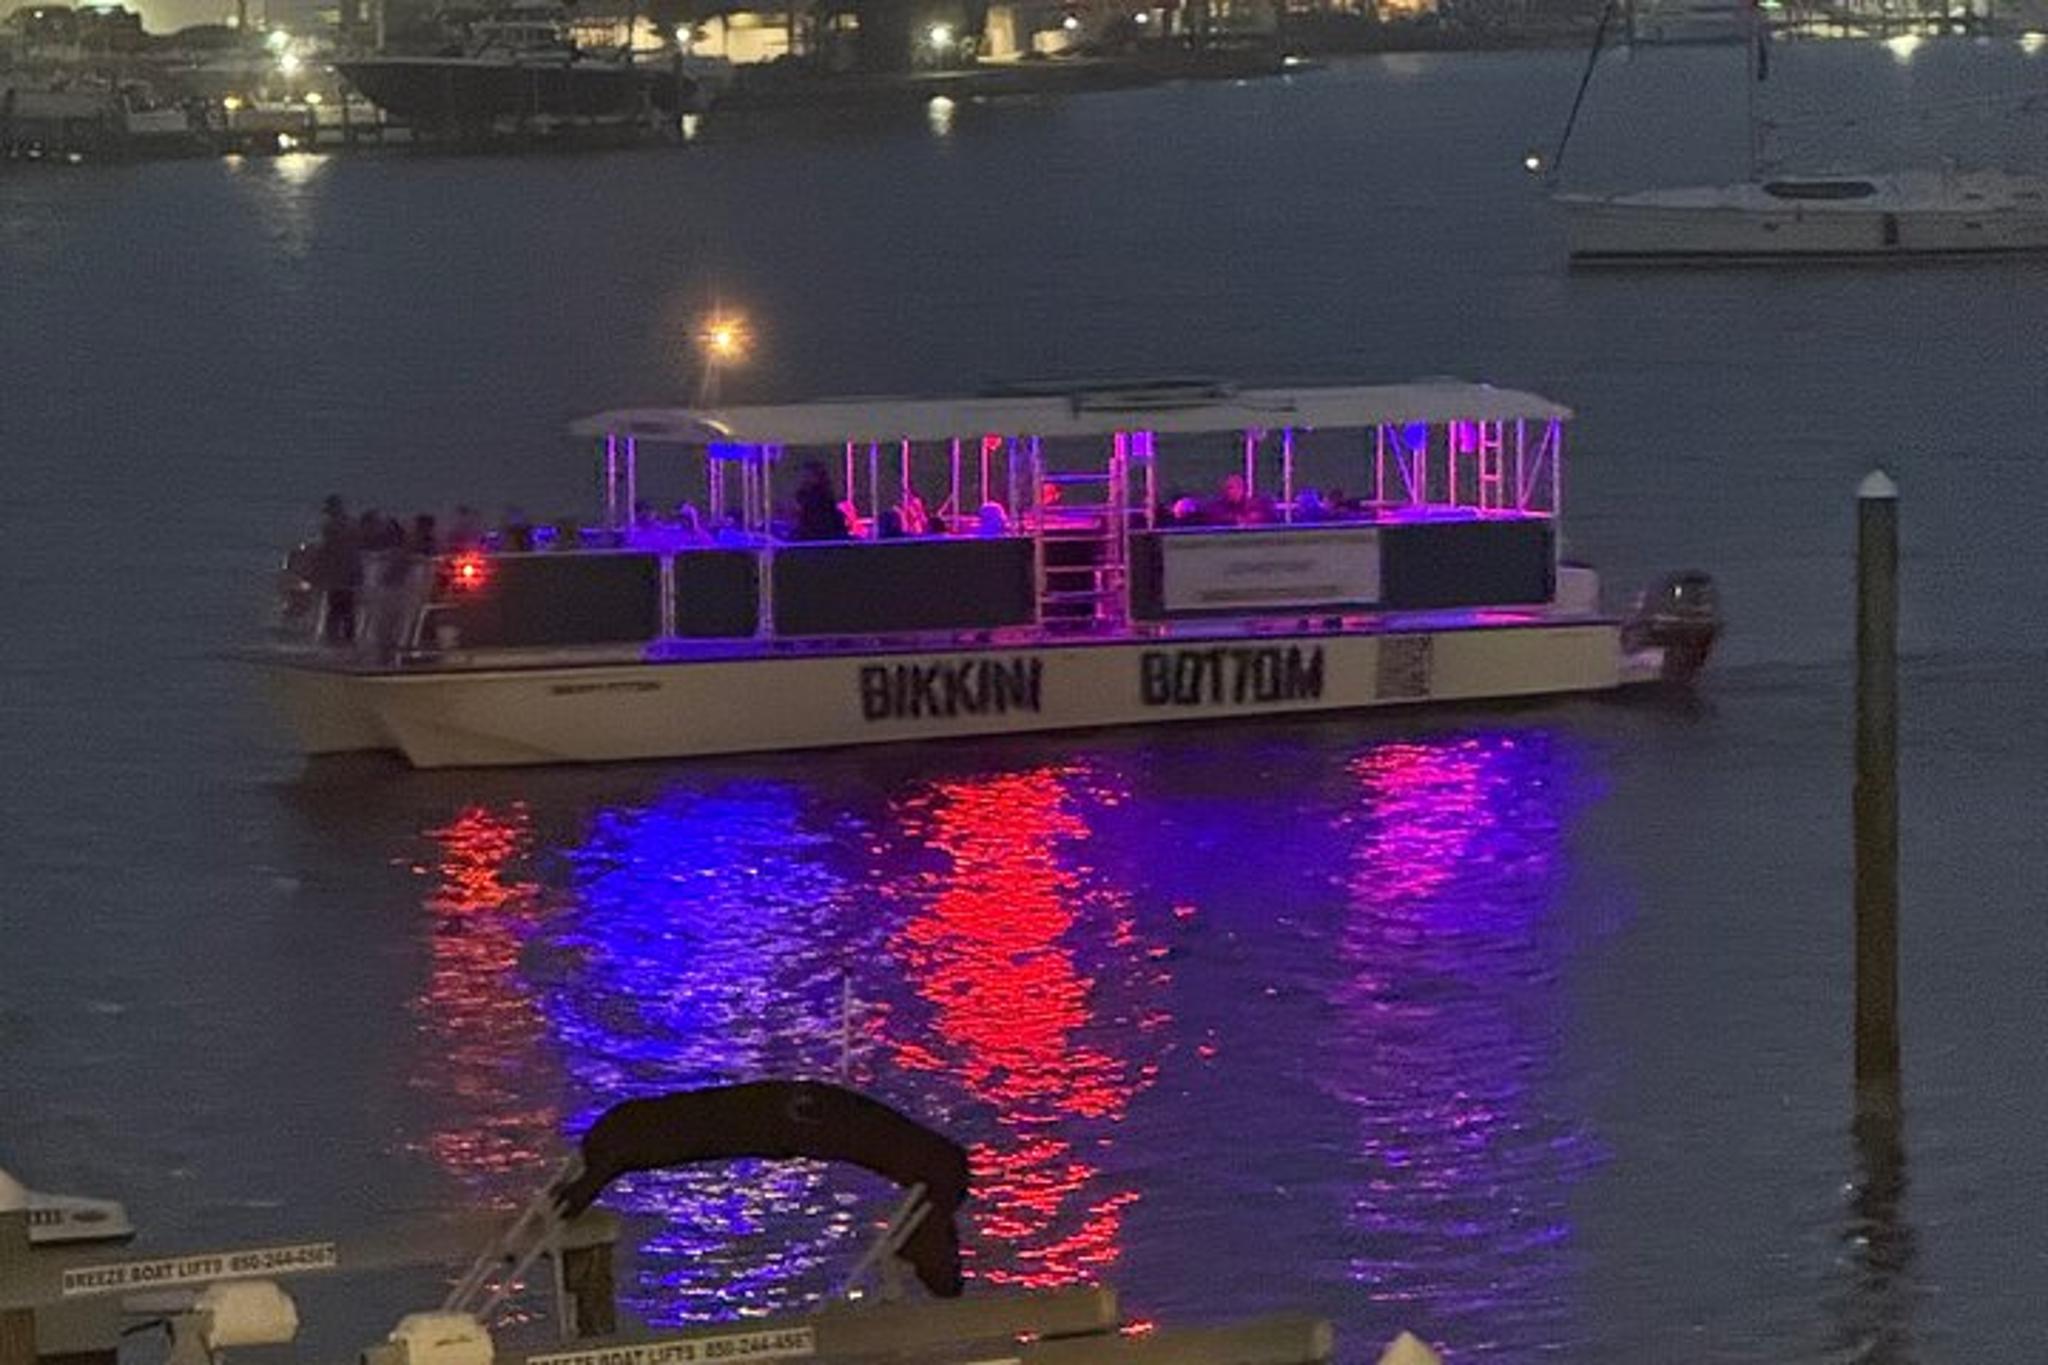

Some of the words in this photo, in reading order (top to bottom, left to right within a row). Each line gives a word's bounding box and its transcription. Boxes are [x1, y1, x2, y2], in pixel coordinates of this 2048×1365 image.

[858, 656, 1044, 722] BIKKINI
[1140, 644, 1326, 706] BOTTOM
[65, 1268, 125, 1289] BREEZE
[131, 1264, 173, 1282] BOAT
[178, 1258, 222, 1278] LIFTS
[600, 1350, 643, 1365] BOAT
[649, 1344, 695, 1364] LIFTS
